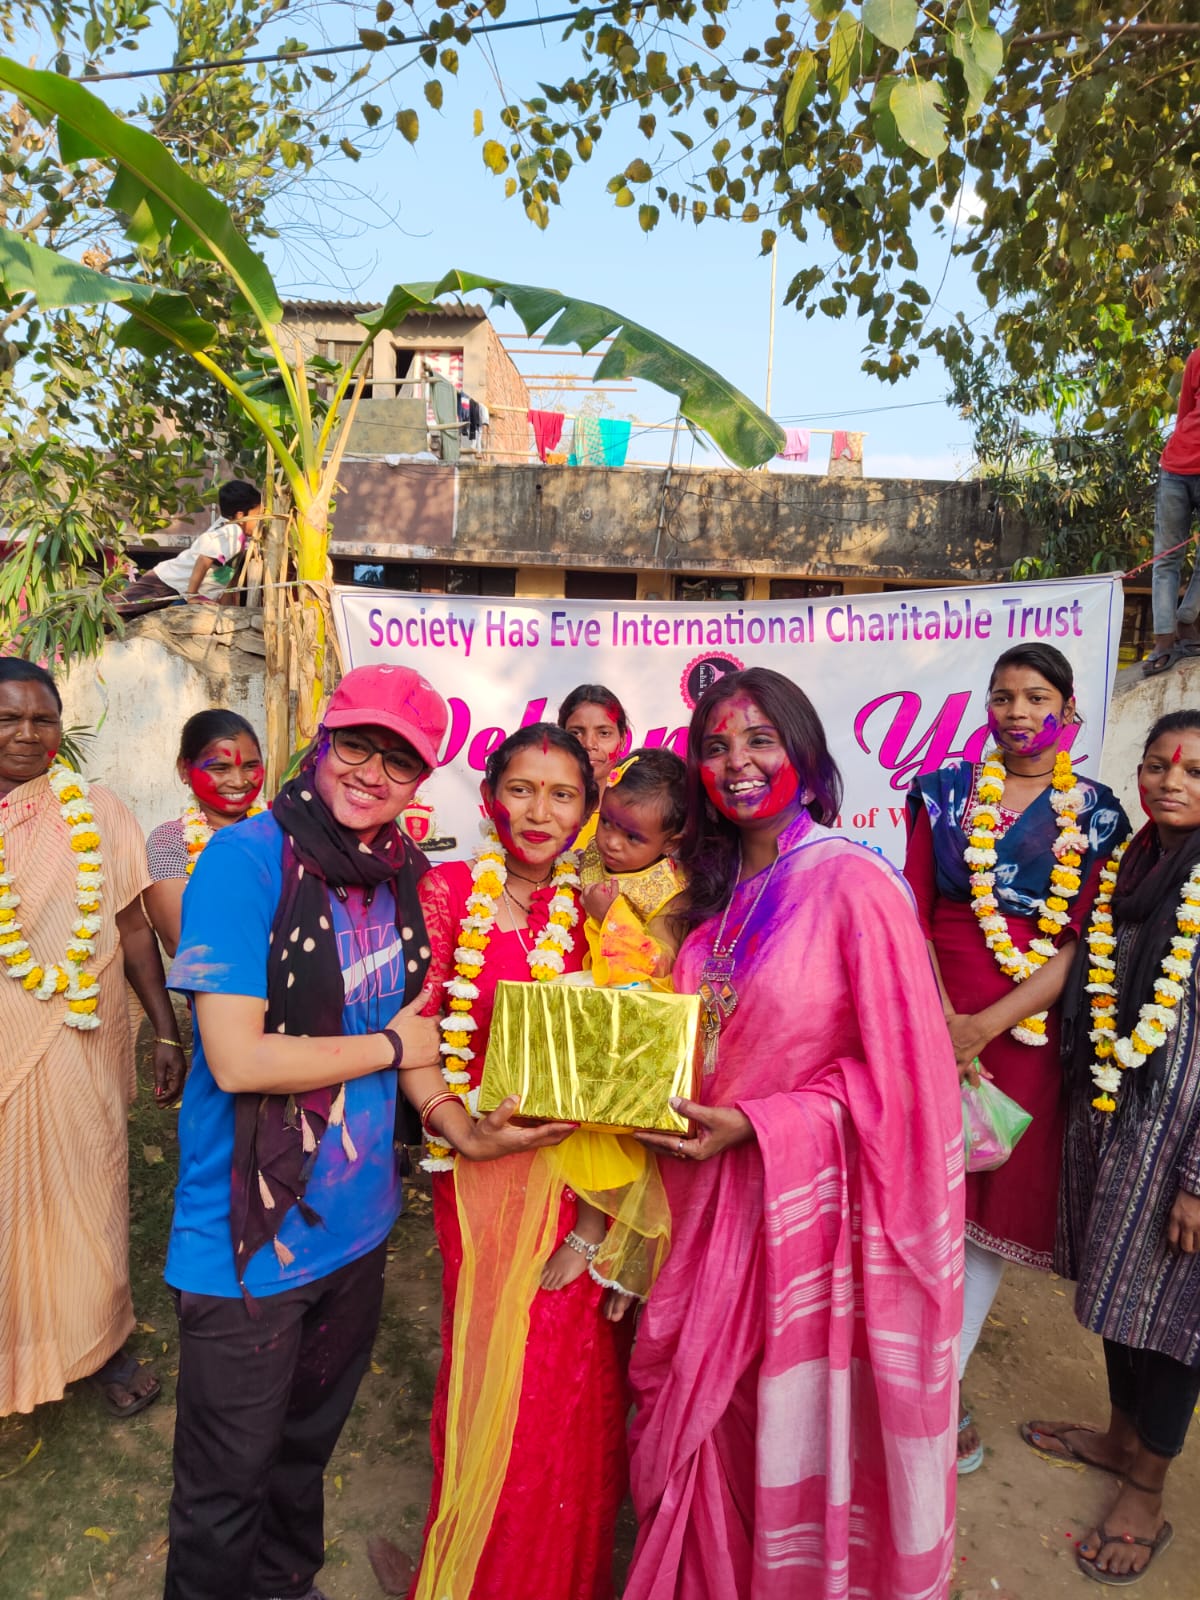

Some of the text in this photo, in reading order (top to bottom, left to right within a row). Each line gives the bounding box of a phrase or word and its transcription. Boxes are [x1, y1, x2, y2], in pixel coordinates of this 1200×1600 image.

[369, 598, 1083, 656] Society Has Eve International Charitable Trust
[852, 807, 880, 829] of
